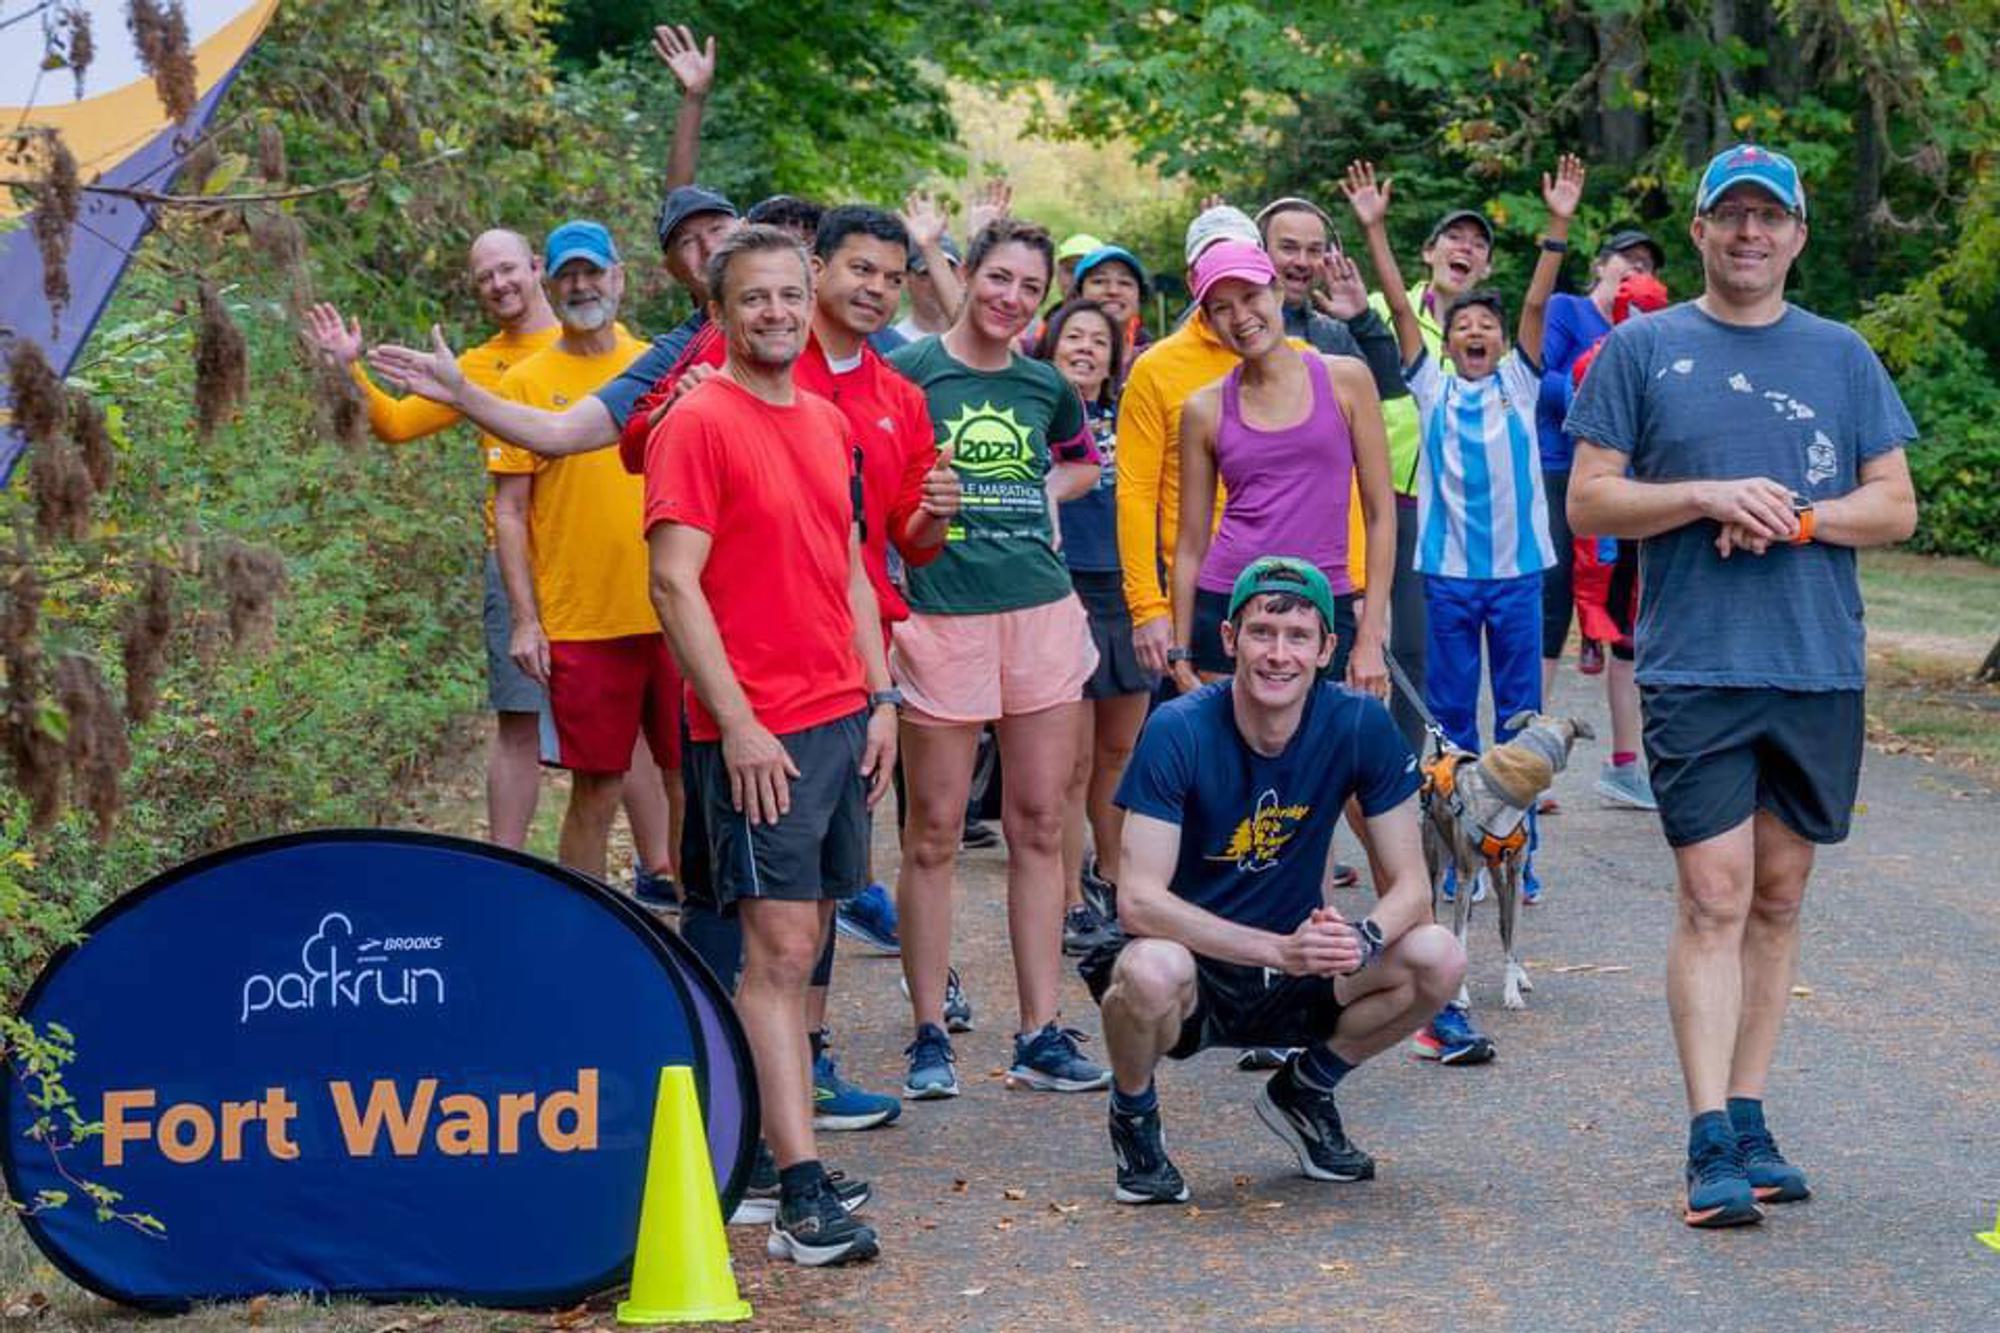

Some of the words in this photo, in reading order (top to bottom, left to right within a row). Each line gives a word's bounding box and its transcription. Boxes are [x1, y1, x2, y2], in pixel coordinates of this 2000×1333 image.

[962, 440, 1017, 462] 2023
[383, 936, 443, 951] BROOKS
[241, 946, 444, 1022] parkrun
[102, 1087, 300, 1166] Fort
[329, 1068, 598, 1156] Ward
